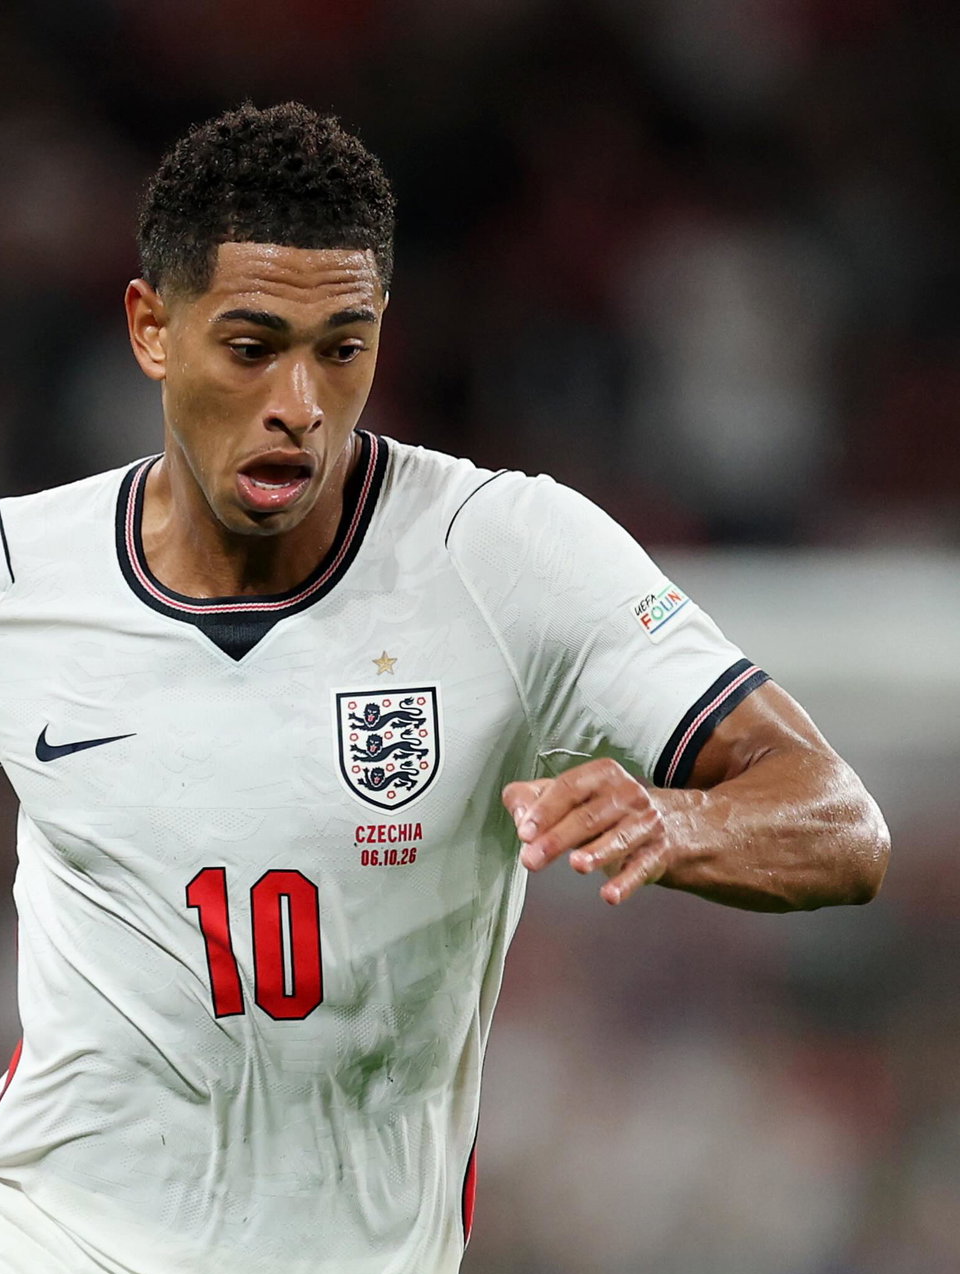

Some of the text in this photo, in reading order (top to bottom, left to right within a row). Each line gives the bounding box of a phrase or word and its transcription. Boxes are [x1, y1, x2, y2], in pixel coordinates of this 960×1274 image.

[634, 594, 657, 616] UEFA
[355, 823, 423, 843] CZECHIA
[361, 847, 417, 866] 06.10.26
[185, 867, 324, 1021] 10
